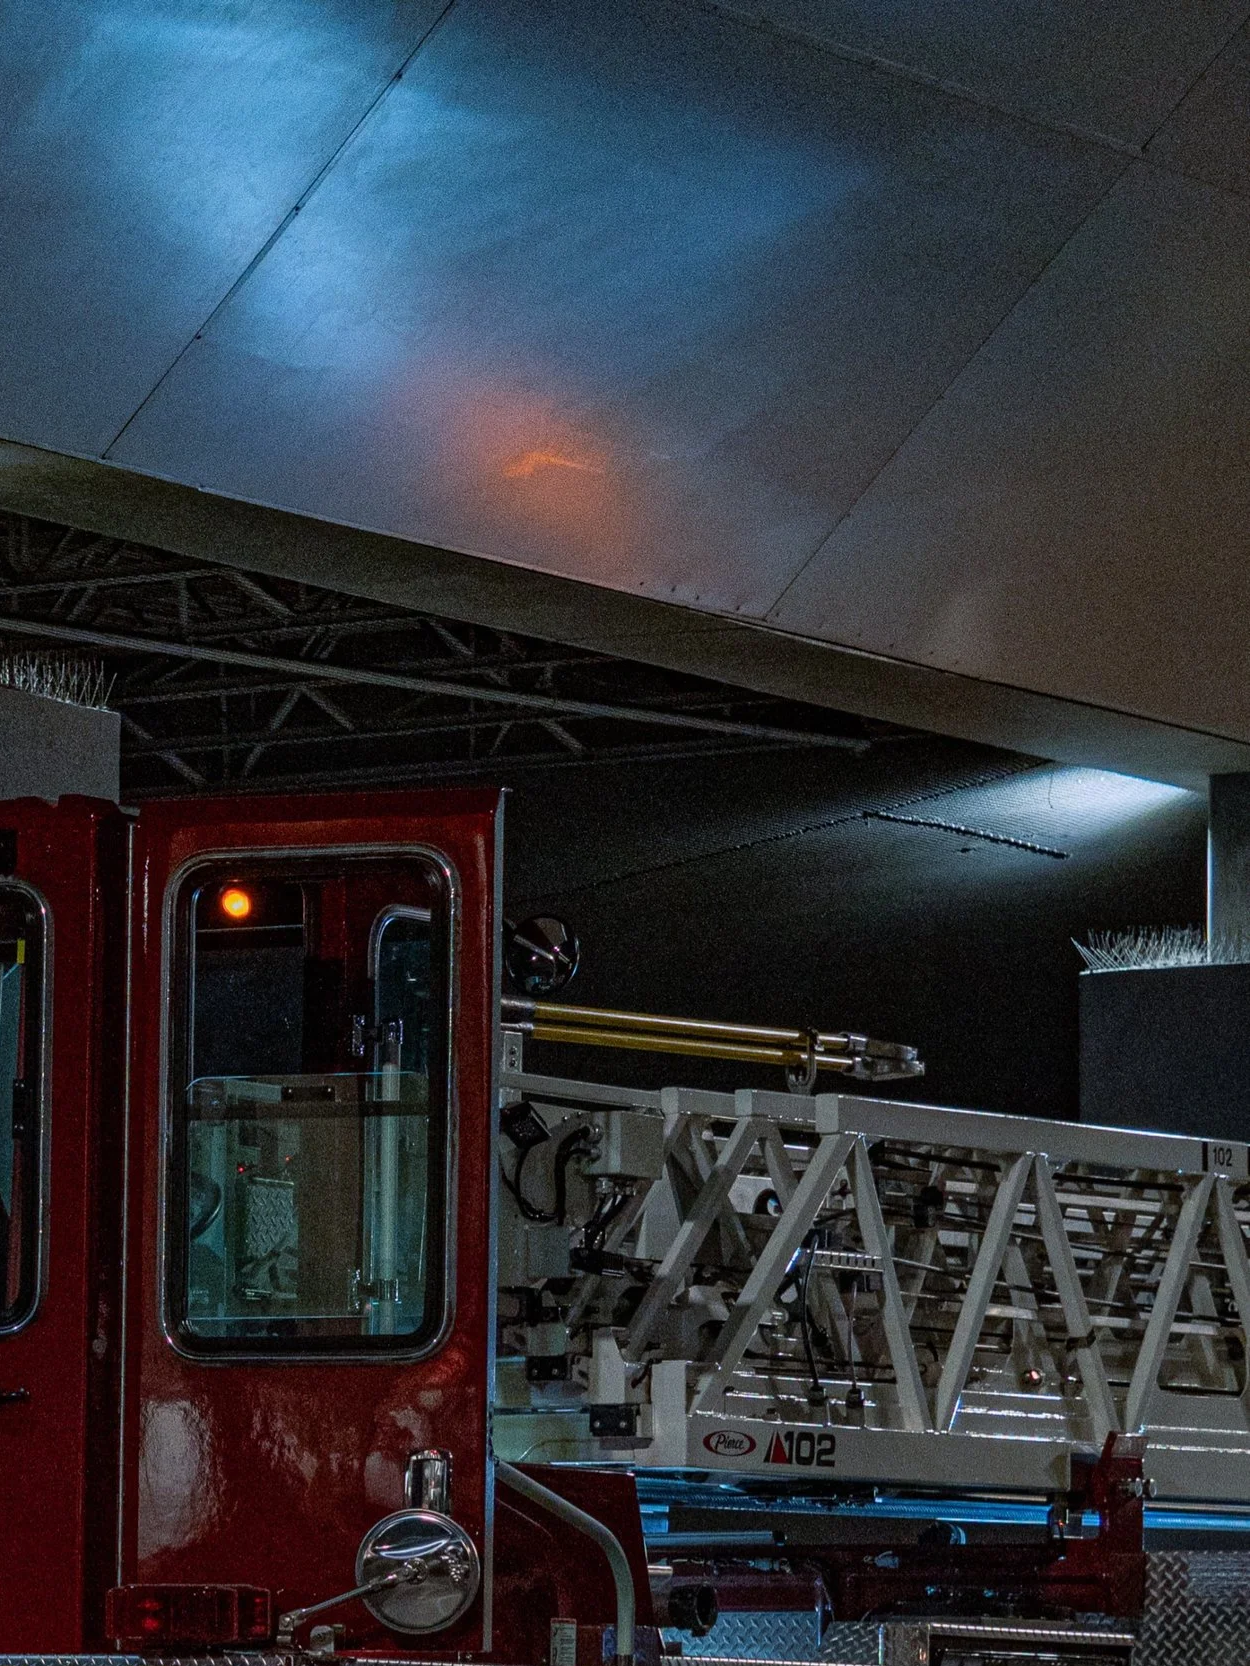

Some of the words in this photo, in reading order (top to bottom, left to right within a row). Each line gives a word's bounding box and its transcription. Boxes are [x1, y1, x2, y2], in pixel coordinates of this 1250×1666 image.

[1213, 1147, 1232, 1167] 102
[715, 1433, 745, 1454] Pierce
[784, 1431, 836, 1468] 102
